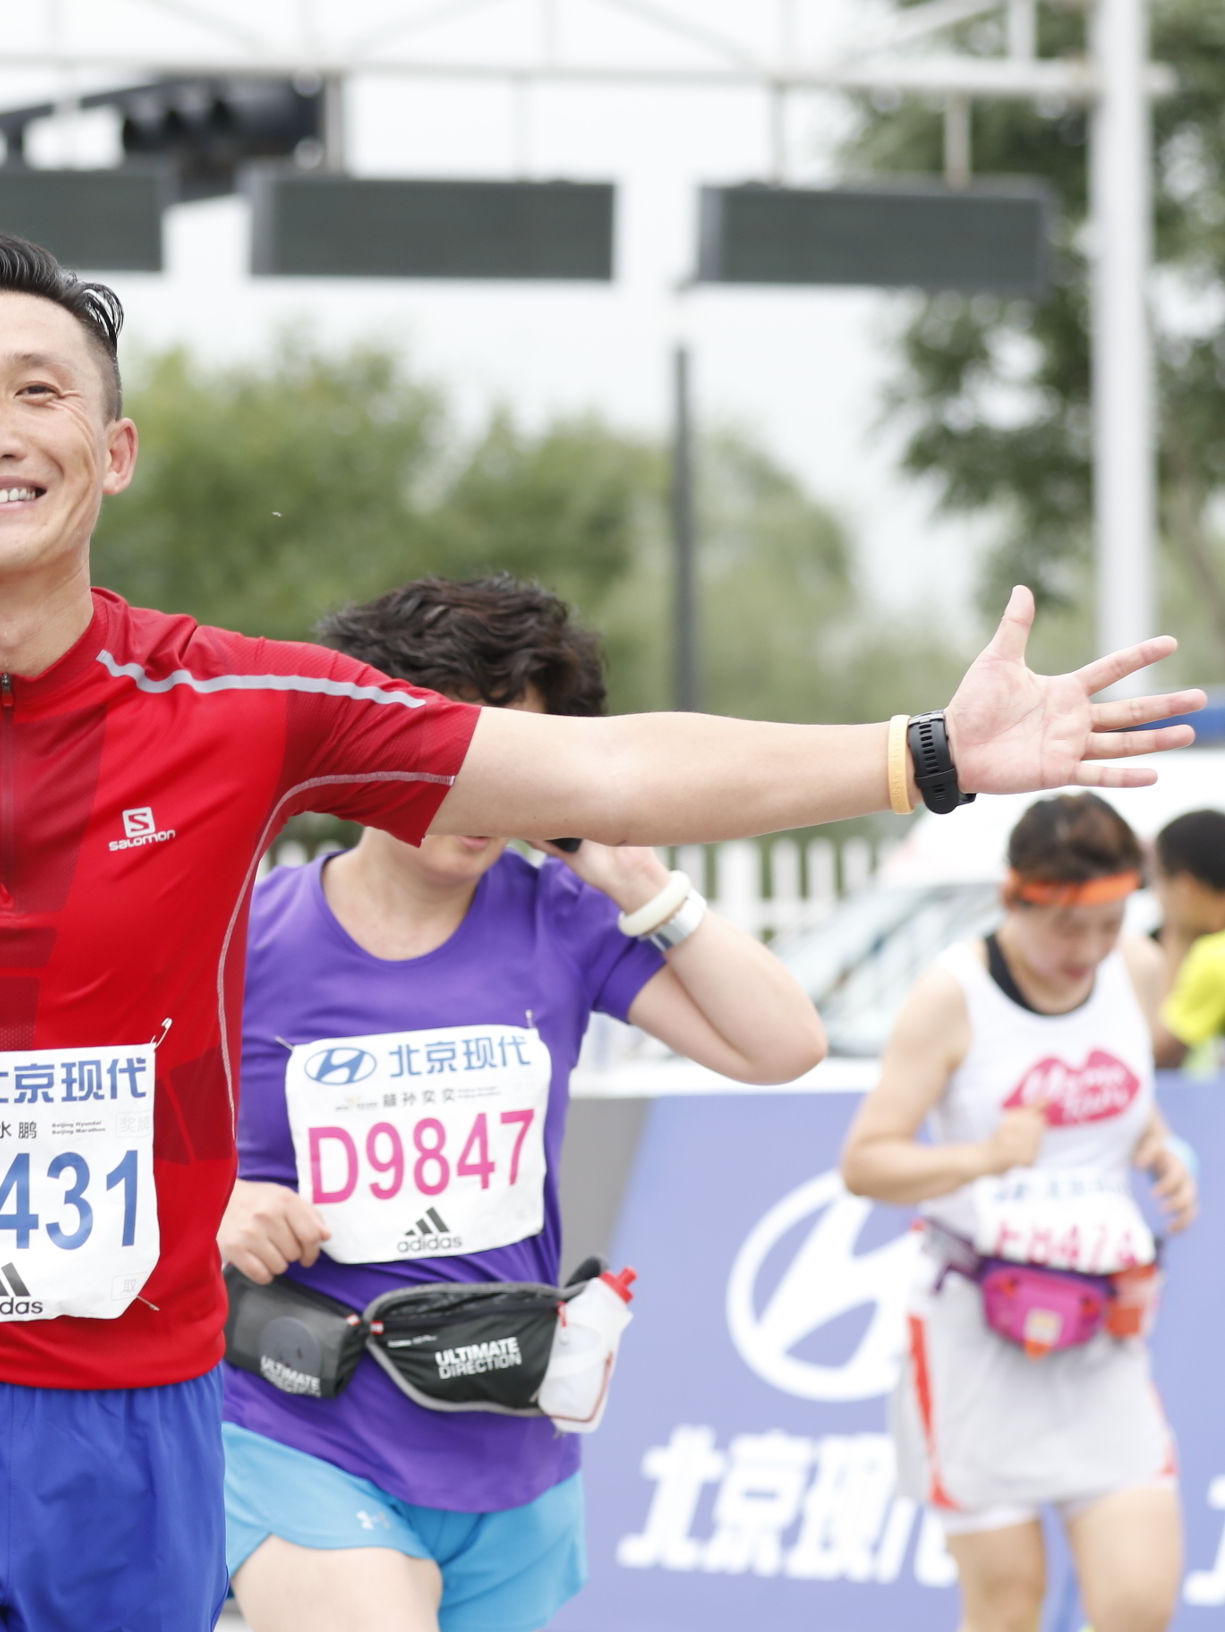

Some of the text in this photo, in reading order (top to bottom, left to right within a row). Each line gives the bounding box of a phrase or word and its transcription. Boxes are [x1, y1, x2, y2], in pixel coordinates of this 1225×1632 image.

[388, 1035, 532, 1078] 北京现代
[308, 1109, 535, 1204] D9847
[397, 1234, 463, 1254] adidas
[434, 1336, 519, 1366] ULTIMATE
[438, 1353, 522, 1379] DIRECTION
